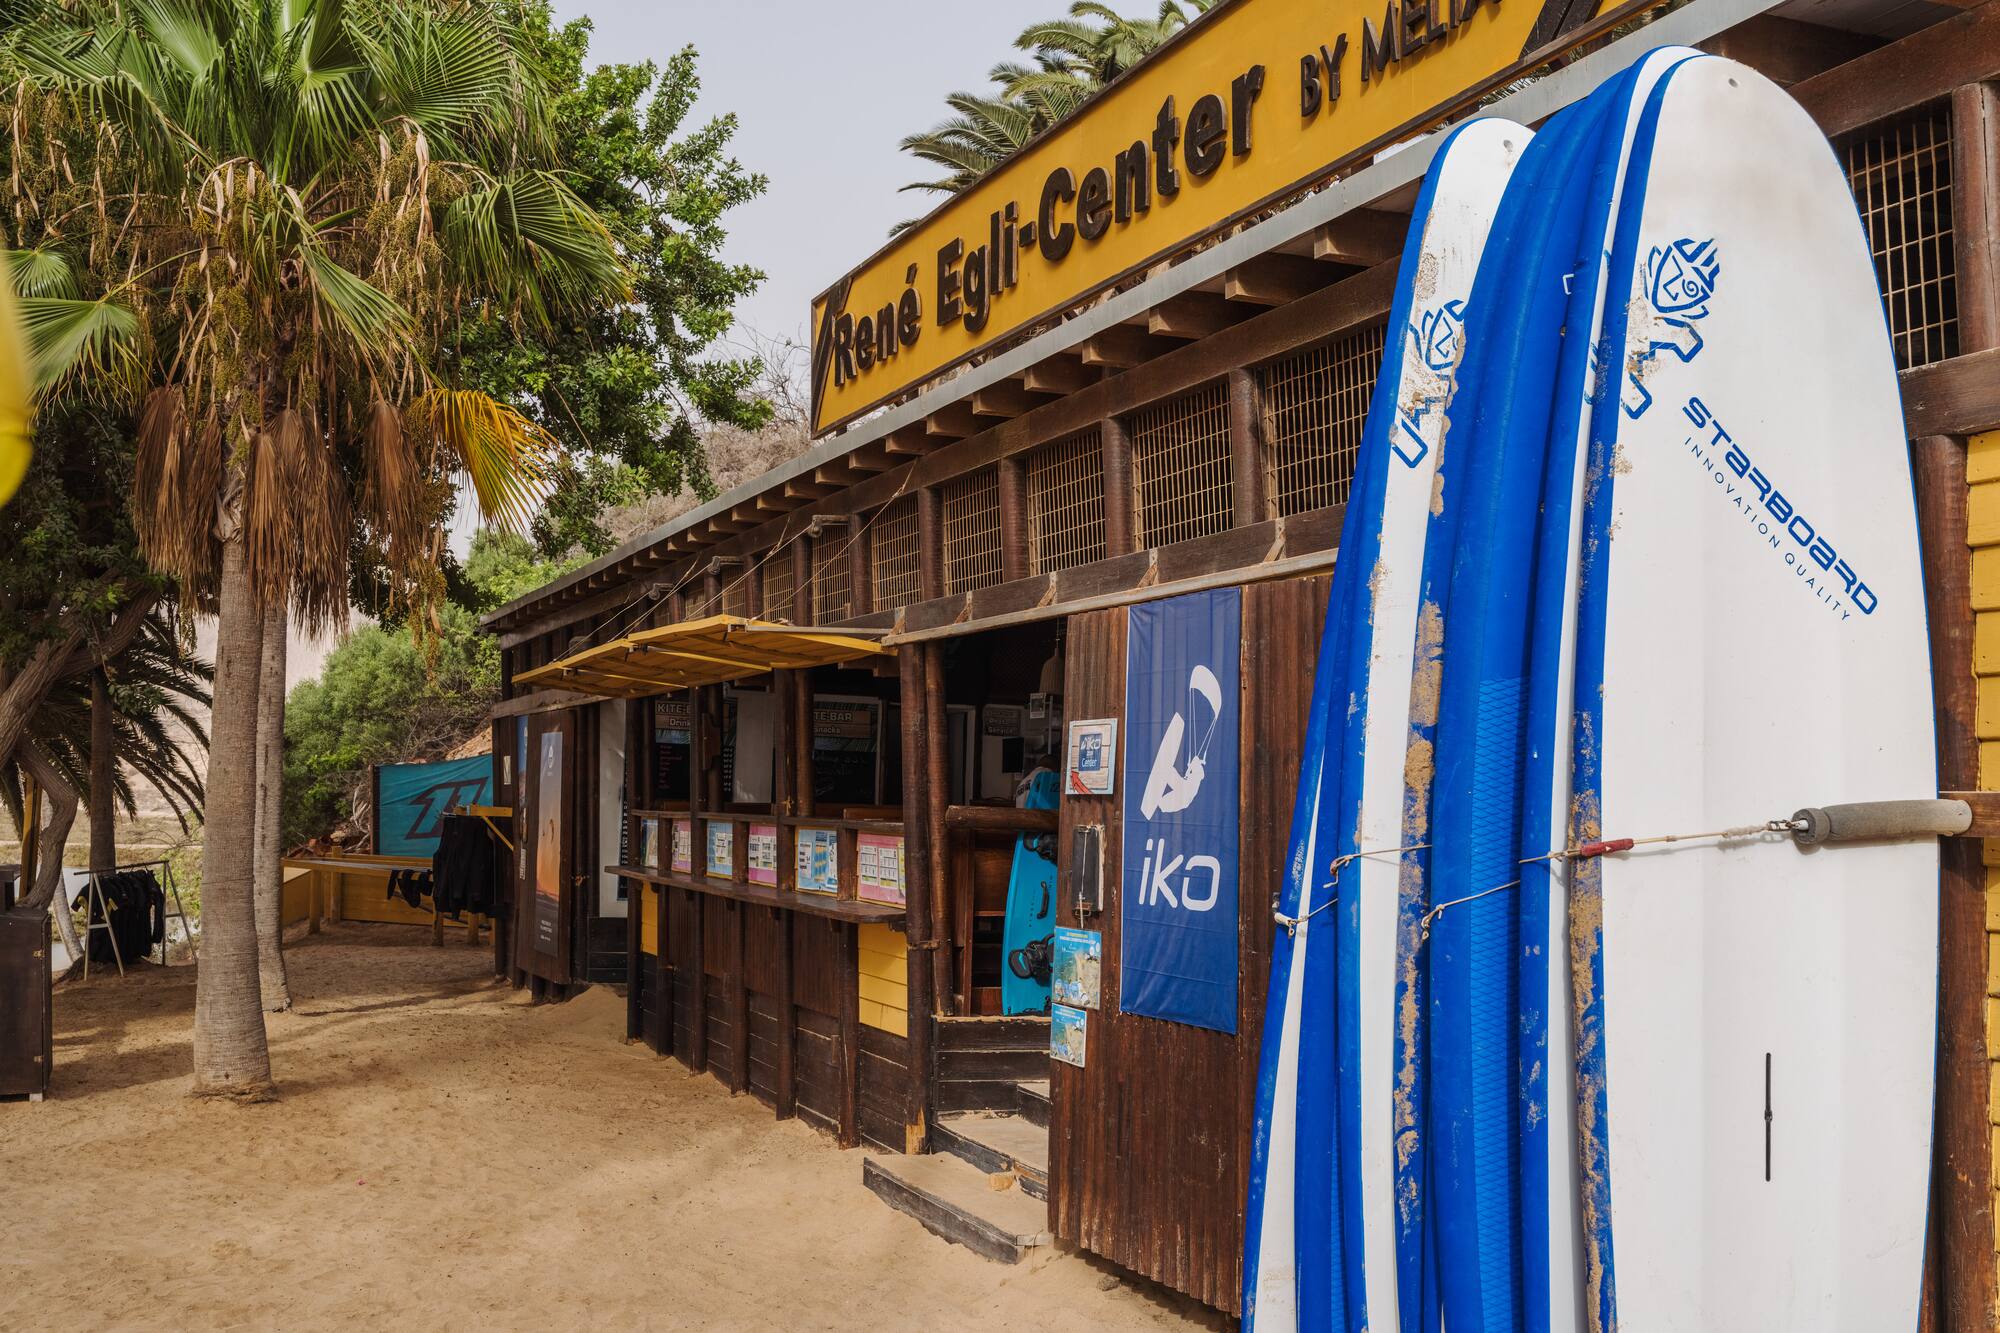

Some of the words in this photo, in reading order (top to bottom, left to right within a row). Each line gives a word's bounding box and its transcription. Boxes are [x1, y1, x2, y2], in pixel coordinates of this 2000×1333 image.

[834, 263, 922, 387] René
[937, 64, 1265, 333] Egli-Center
[1300, 32, 1348, 117] BY
[1684, 436, 1781, 549] INNOVATION
[1785, 552, 1850, 621] QUALITY
[1138, 838, 1221, 912] iko
